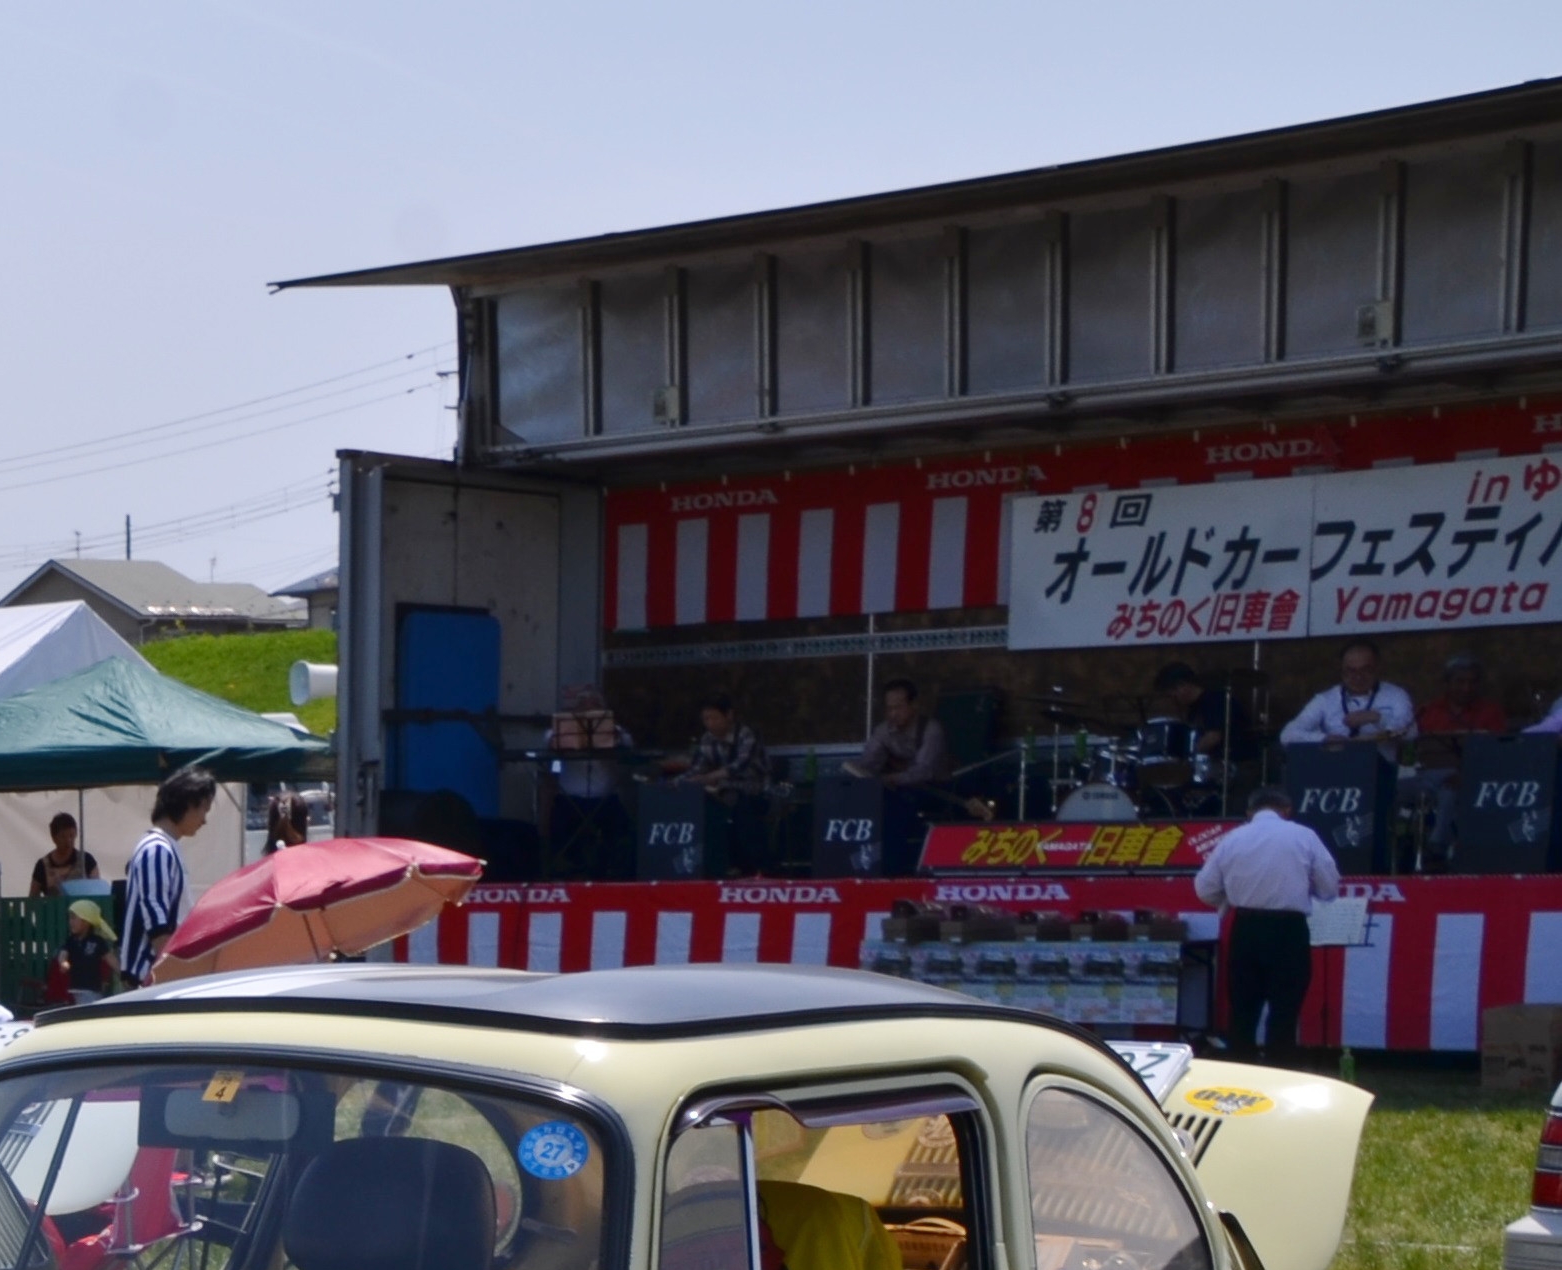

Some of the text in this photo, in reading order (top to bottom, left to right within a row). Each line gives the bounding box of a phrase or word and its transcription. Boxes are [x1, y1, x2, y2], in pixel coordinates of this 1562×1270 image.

[1206, 438, 1342, 465] HONDA
[926, 464, 1047, 490] HONDA
[1467, 457, 1561, 505] in ゆ
[671, 488, 779, 513] HONDA
[1034, 493, 1154, 534] 第8回
[1334, 581, 1550, 625] Yamagata
[1299, 787, 1362, 814] FCB
[1474, 781, 1540, 808] FCB
[648, 822, 695, 845] FCB
[825, 818, 873, 842] FCB
[463, 887, 572, 905] HONDA
[719, 886, 842, 905] HONDA
[934, 884, 1070, 902] HONDA
